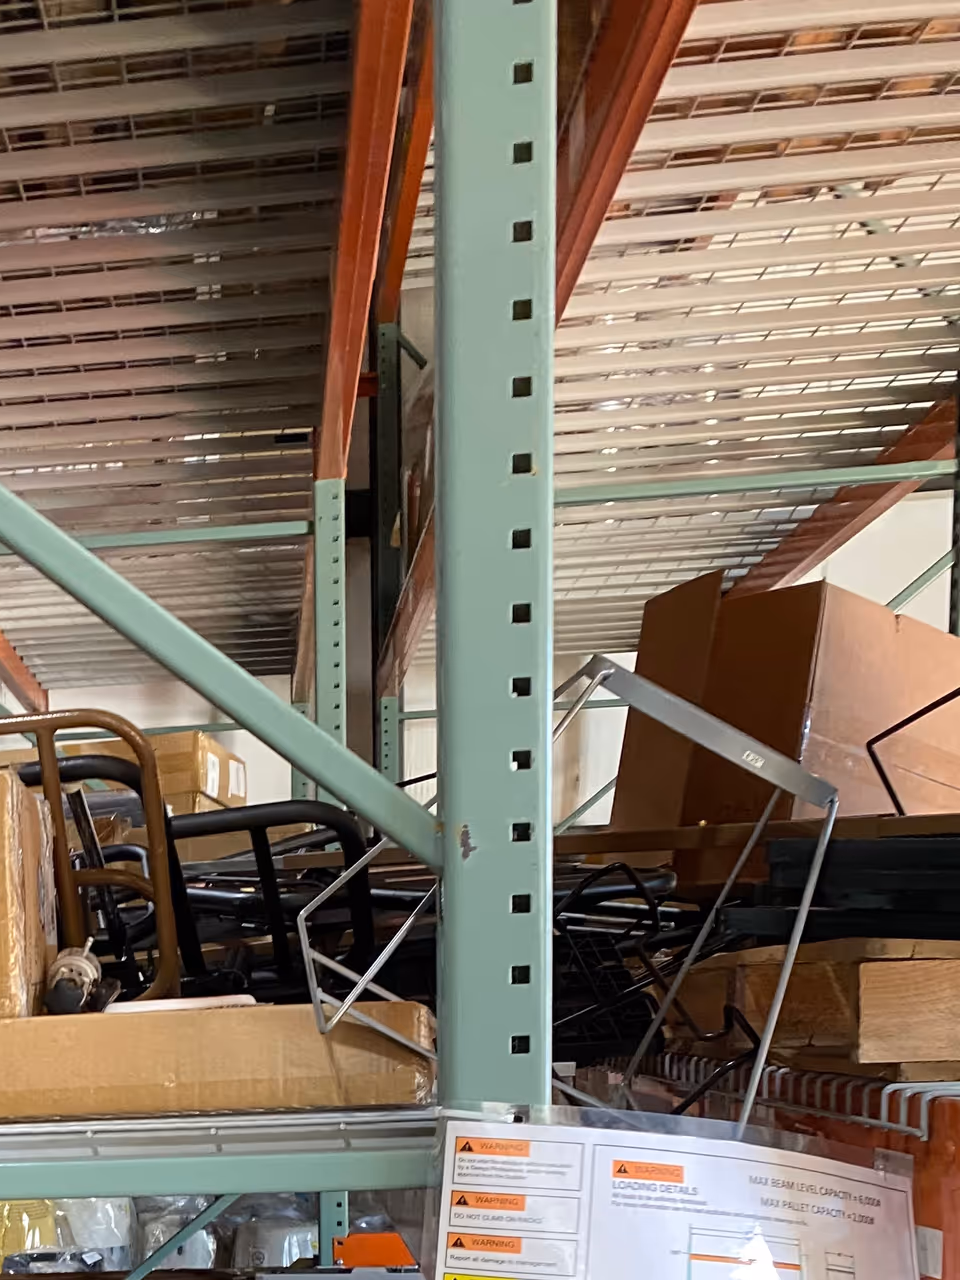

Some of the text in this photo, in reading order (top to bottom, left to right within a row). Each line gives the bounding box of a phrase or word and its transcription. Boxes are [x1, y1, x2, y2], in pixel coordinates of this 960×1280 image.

[480, 1141, 524, 1152] WARNING
[612, 1180, 699, 1195] LOADING DETAILS
[748, 1175, 768, 1186] MAX
[771, 1178, 795, 1190] BEAM
[797, 1183, 819, 1195] LEVEL
[820, 1186, 852, 1202] CAPACITY
[475, 1195, 519, 1206] WARNING
[760, 1197, 780, 1208] MAX
[782, 1200, 809, 1212] PALLET
[811, 1204, 845, 1219] CAPACITY
[454, 1212, 464, 1220] DO
[472, 1238, 515, 1249] WARNING
